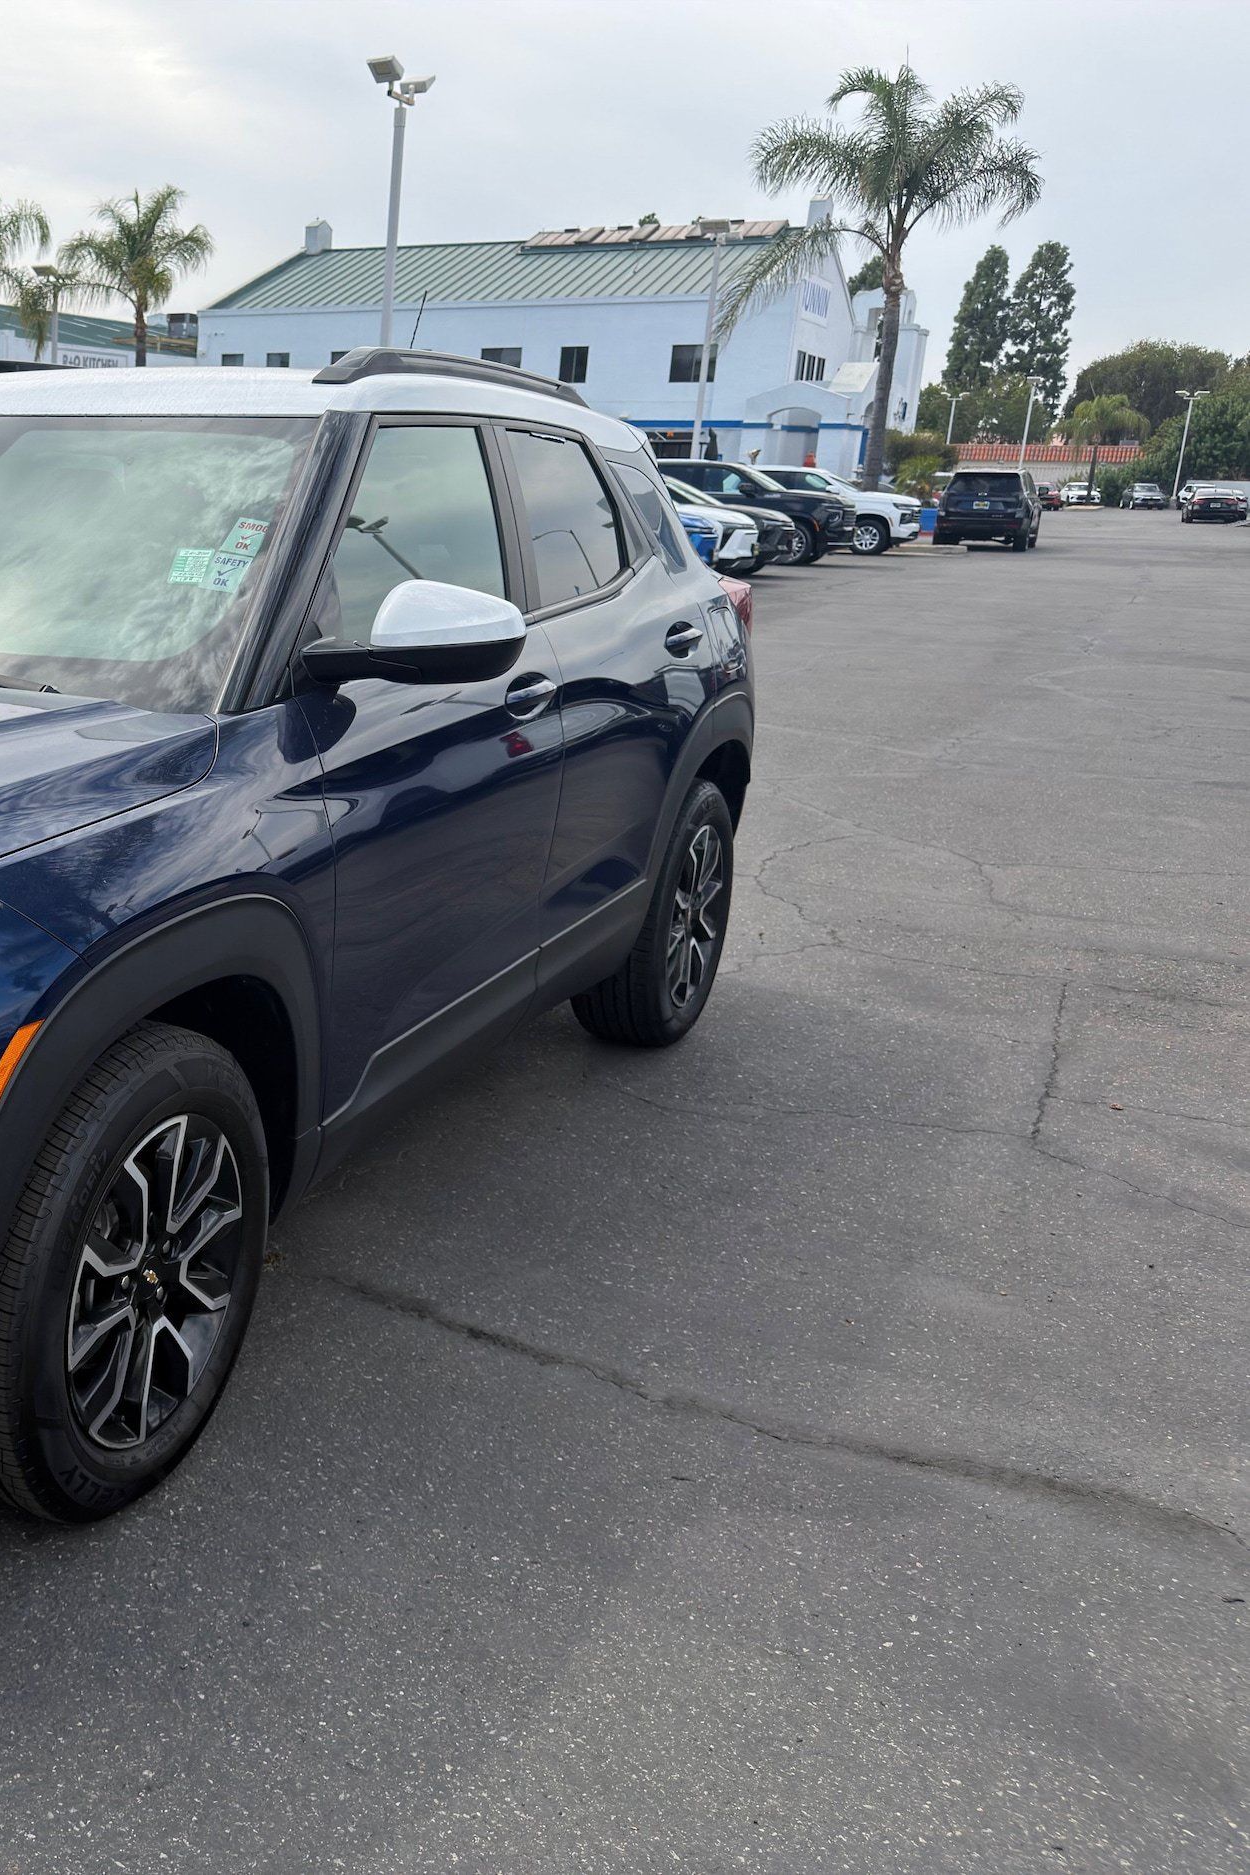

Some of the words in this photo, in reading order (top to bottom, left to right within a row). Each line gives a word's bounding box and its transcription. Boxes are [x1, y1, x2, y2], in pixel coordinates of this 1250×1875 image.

[235, 541, 251, 550] OK
[214, 556, 249, 568] SAFETY
[213, 577, 229, 587] OK
